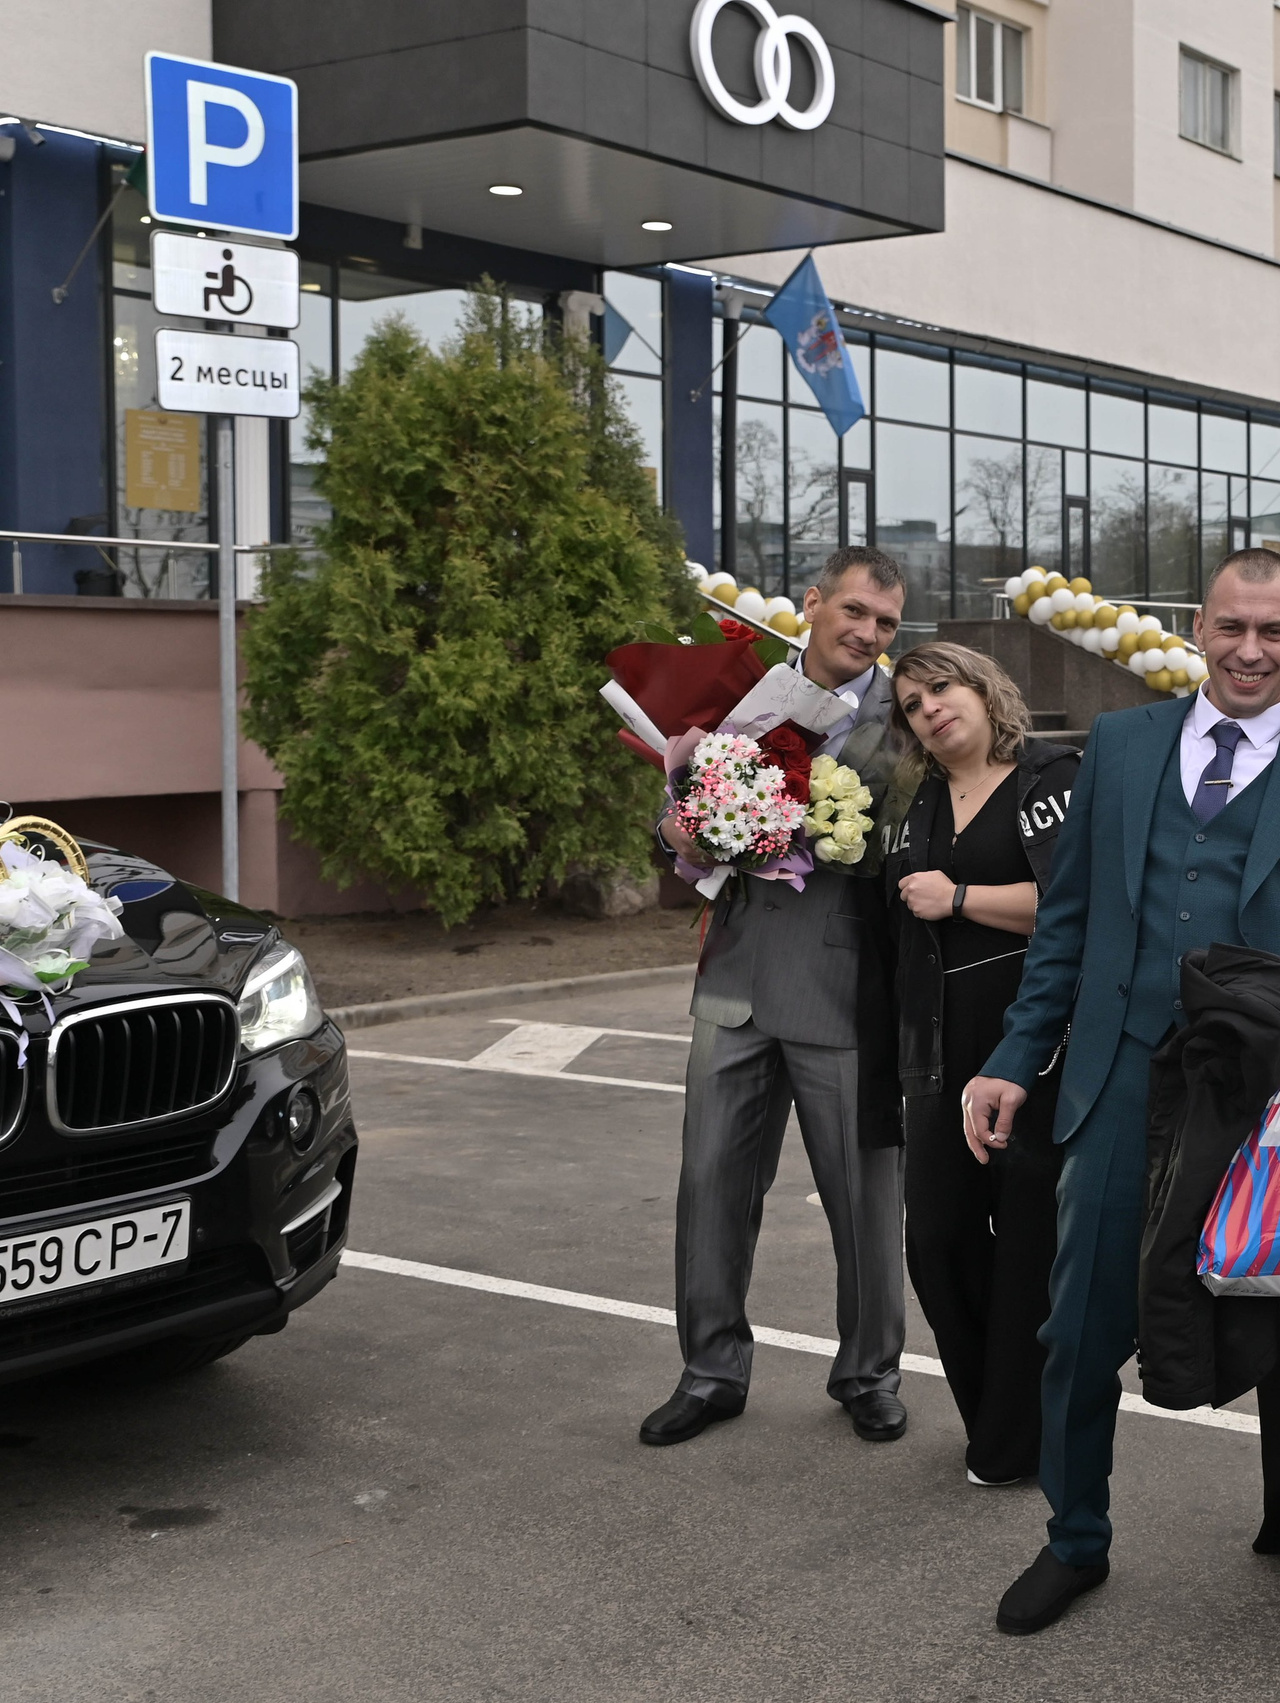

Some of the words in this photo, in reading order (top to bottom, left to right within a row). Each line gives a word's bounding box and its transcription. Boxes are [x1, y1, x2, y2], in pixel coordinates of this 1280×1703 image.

[187, 80, 265, 206] P
[170, 356, 185, 382] 2
[196, 366, 289, 391] месцы
